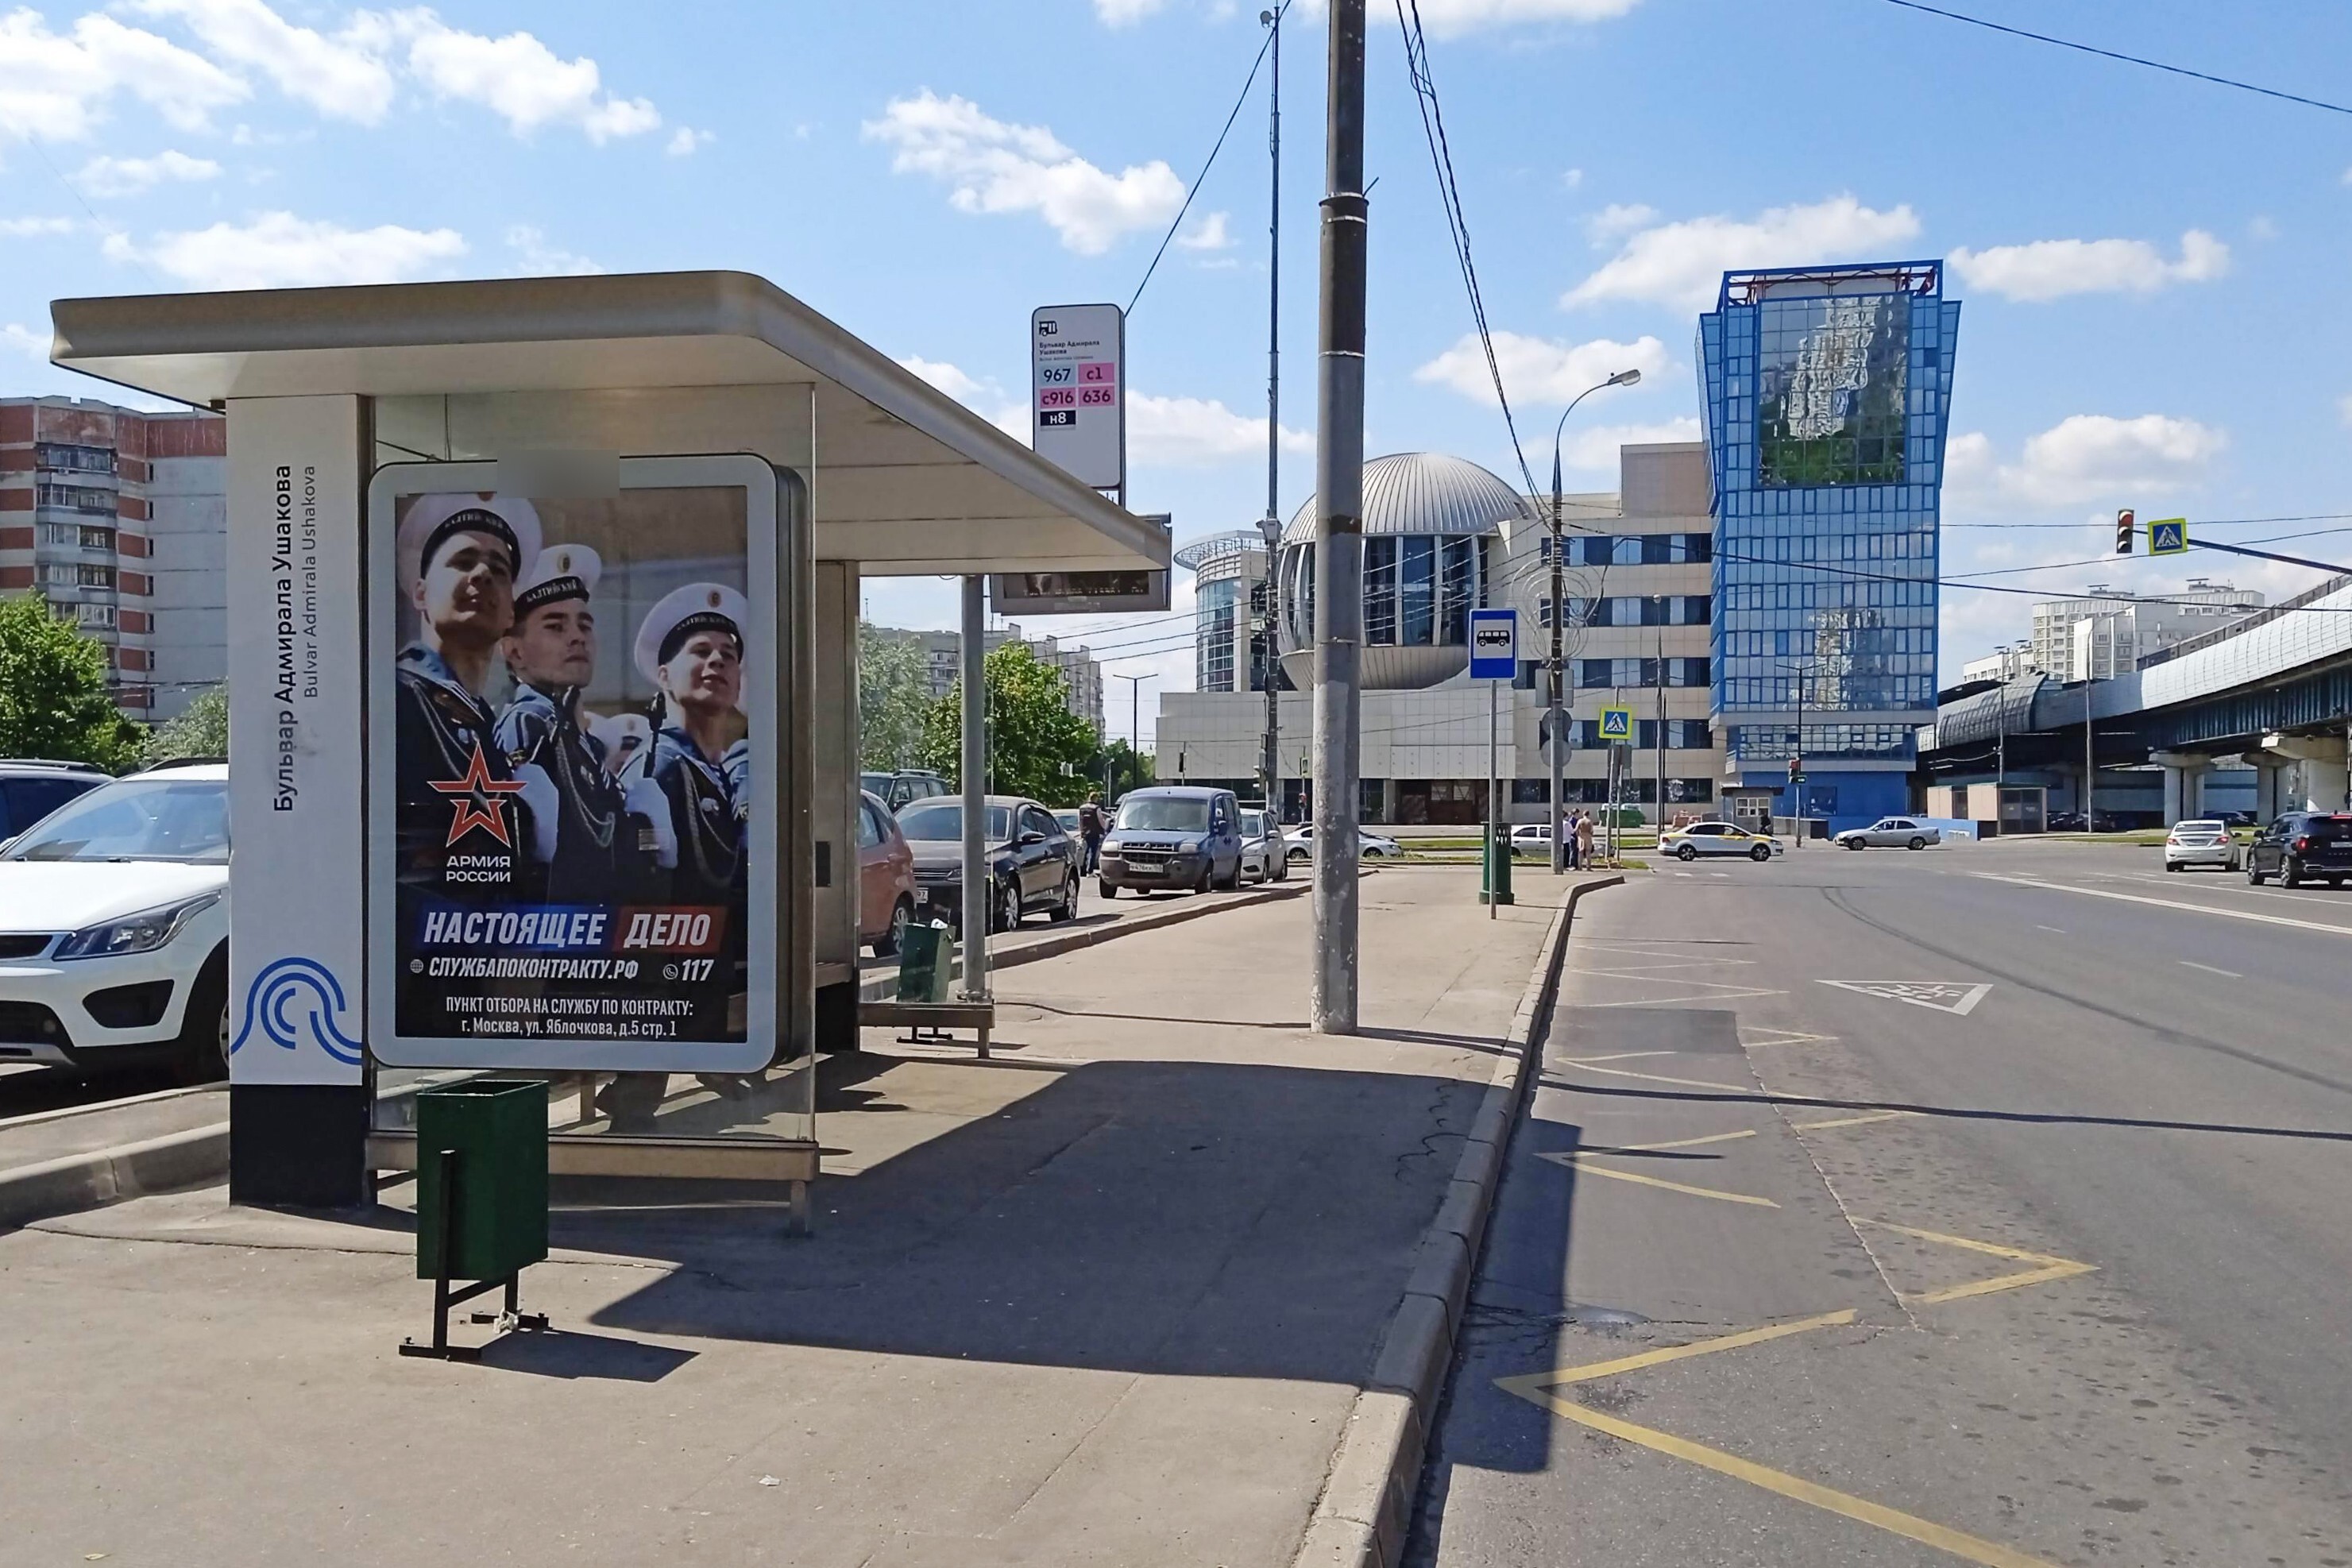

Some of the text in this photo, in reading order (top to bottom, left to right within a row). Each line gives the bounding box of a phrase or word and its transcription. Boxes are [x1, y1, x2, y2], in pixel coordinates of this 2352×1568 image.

[1043, 368, 1071, 382] 967
[1083, 390, 1111, 403] 636
[302, 465, 318, 698] Bulvar Admirala Ushakova
[272, 465, 298, 812] Бульвар Адмирала Ушакова
[446, 855, 512, 868] АРМИЯ
[445, 870, 512, 883] РОССИИ
[423, 912, 712, 948] НАСТОЯЩЕЕ ДЕЛО
[428, 956, 715, 982] СЛУЖБАПОКОНТРАКТУ.РФ 117
[446, 996, 693, 1016] ПУНКТ ОТБОРА НА СЛУЖБУ ПО КОНТРАКТУ:
[462, 1017, 677, 1039] г. Москва, ул. Яблочкова, д.5 стр. 1
